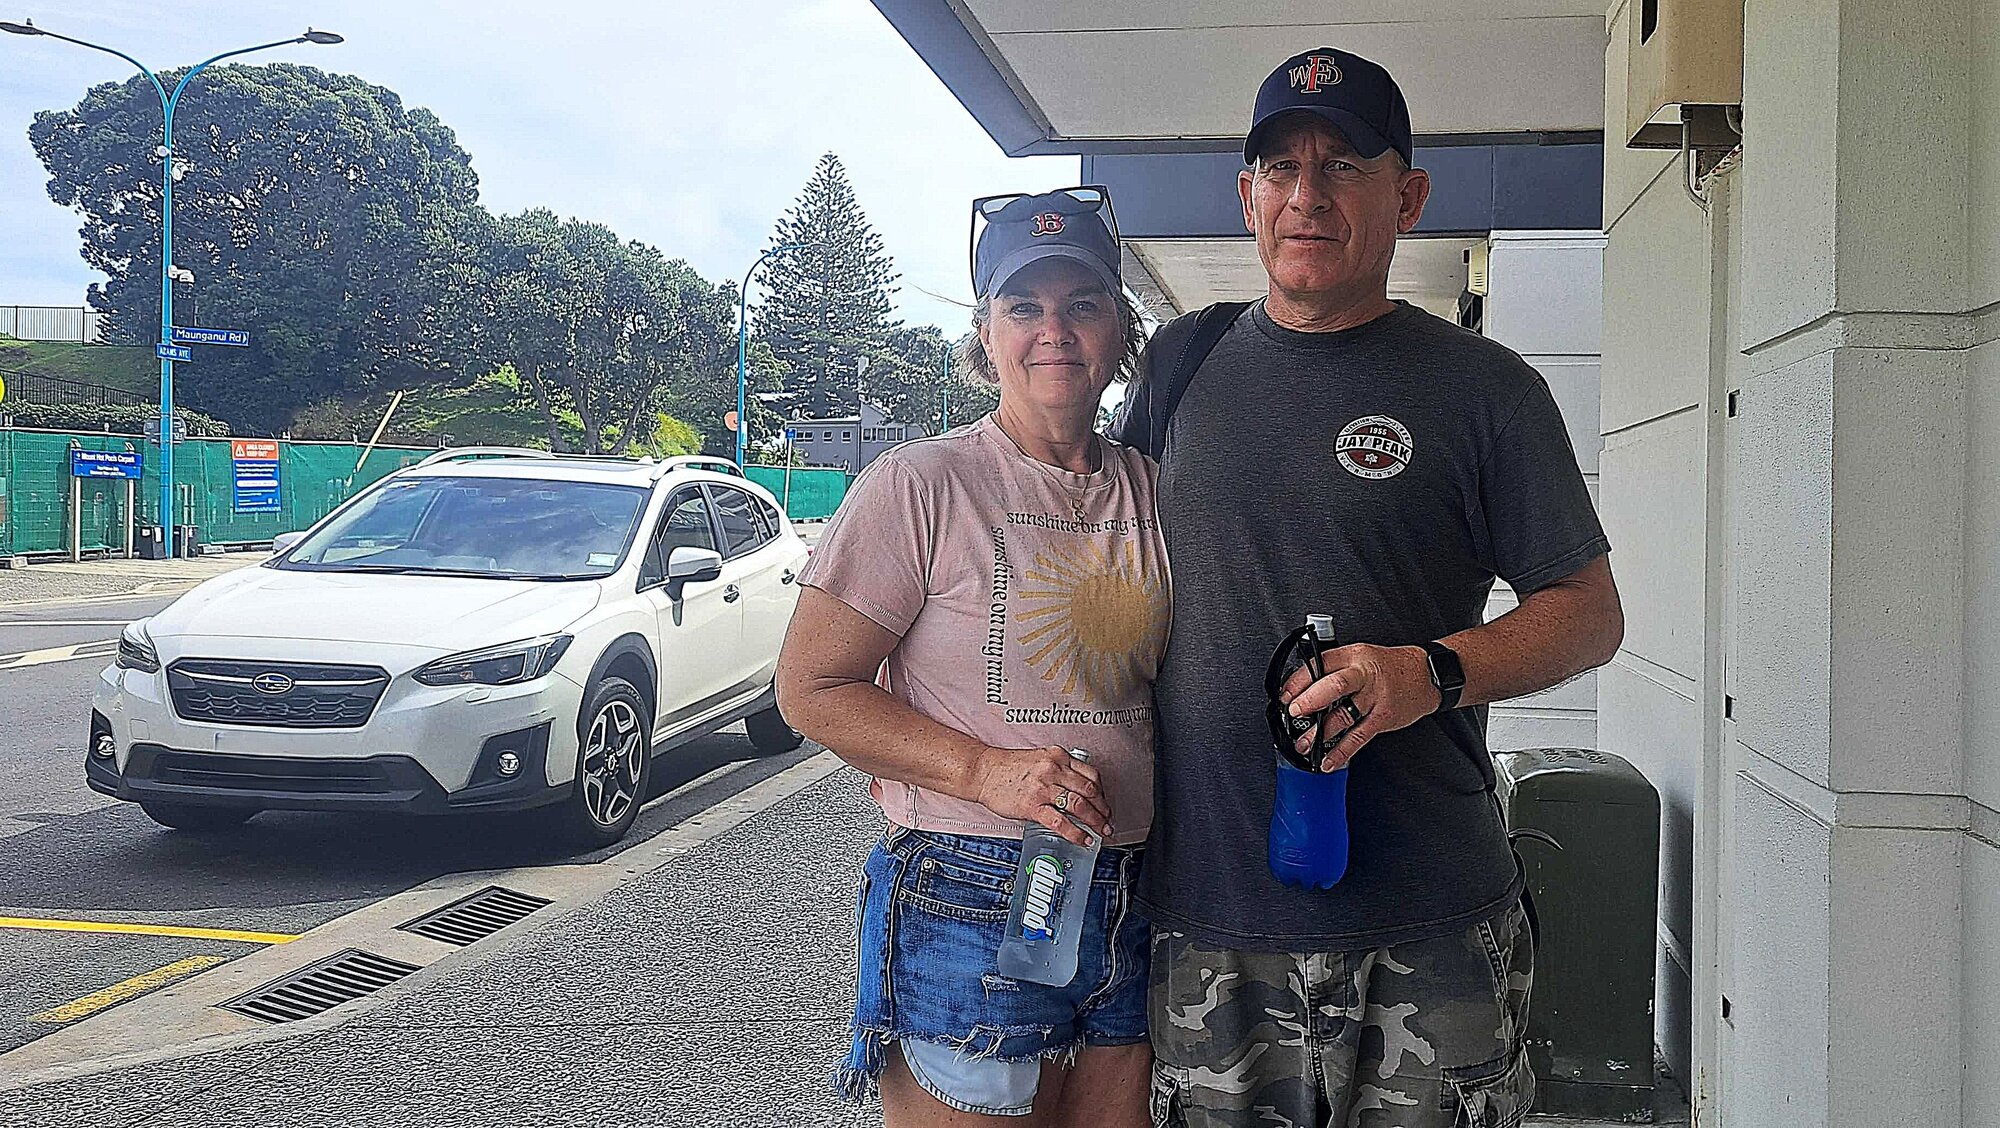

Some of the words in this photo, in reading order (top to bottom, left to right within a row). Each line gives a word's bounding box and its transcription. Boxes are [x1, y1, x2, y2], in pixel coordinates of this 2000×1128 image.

[1031, 212, 1066, 236] B
[176, 329, 227, 342] Maunganui
[228, 333, 241, 342] Rd
[159, 346, 177, 356] ADAMS
[178, 349, 189, 358] AVE
[1369, 426, 1388, 436] 1955
[1337, 436, 1368, 449] JAY
[1372, 437, 1410, 463] PEAK
[1006, 511, 1080, 533] sunshine
[1081, 521, 1101, 534] on
[1103, 518, 1129, 536] my
[991, 525, 1014, 601] sunshine
[990, 602, 1007, 625] on
[982, 627, 1005, 657] my
[986, 659, 1009, 705] mind
[1005, 702, 1091, 724] sunshine
[1092, 710, 1113, 725] on
[1114, 709, 1134, 728] my
[1022, 858, 1065, 937] pump
